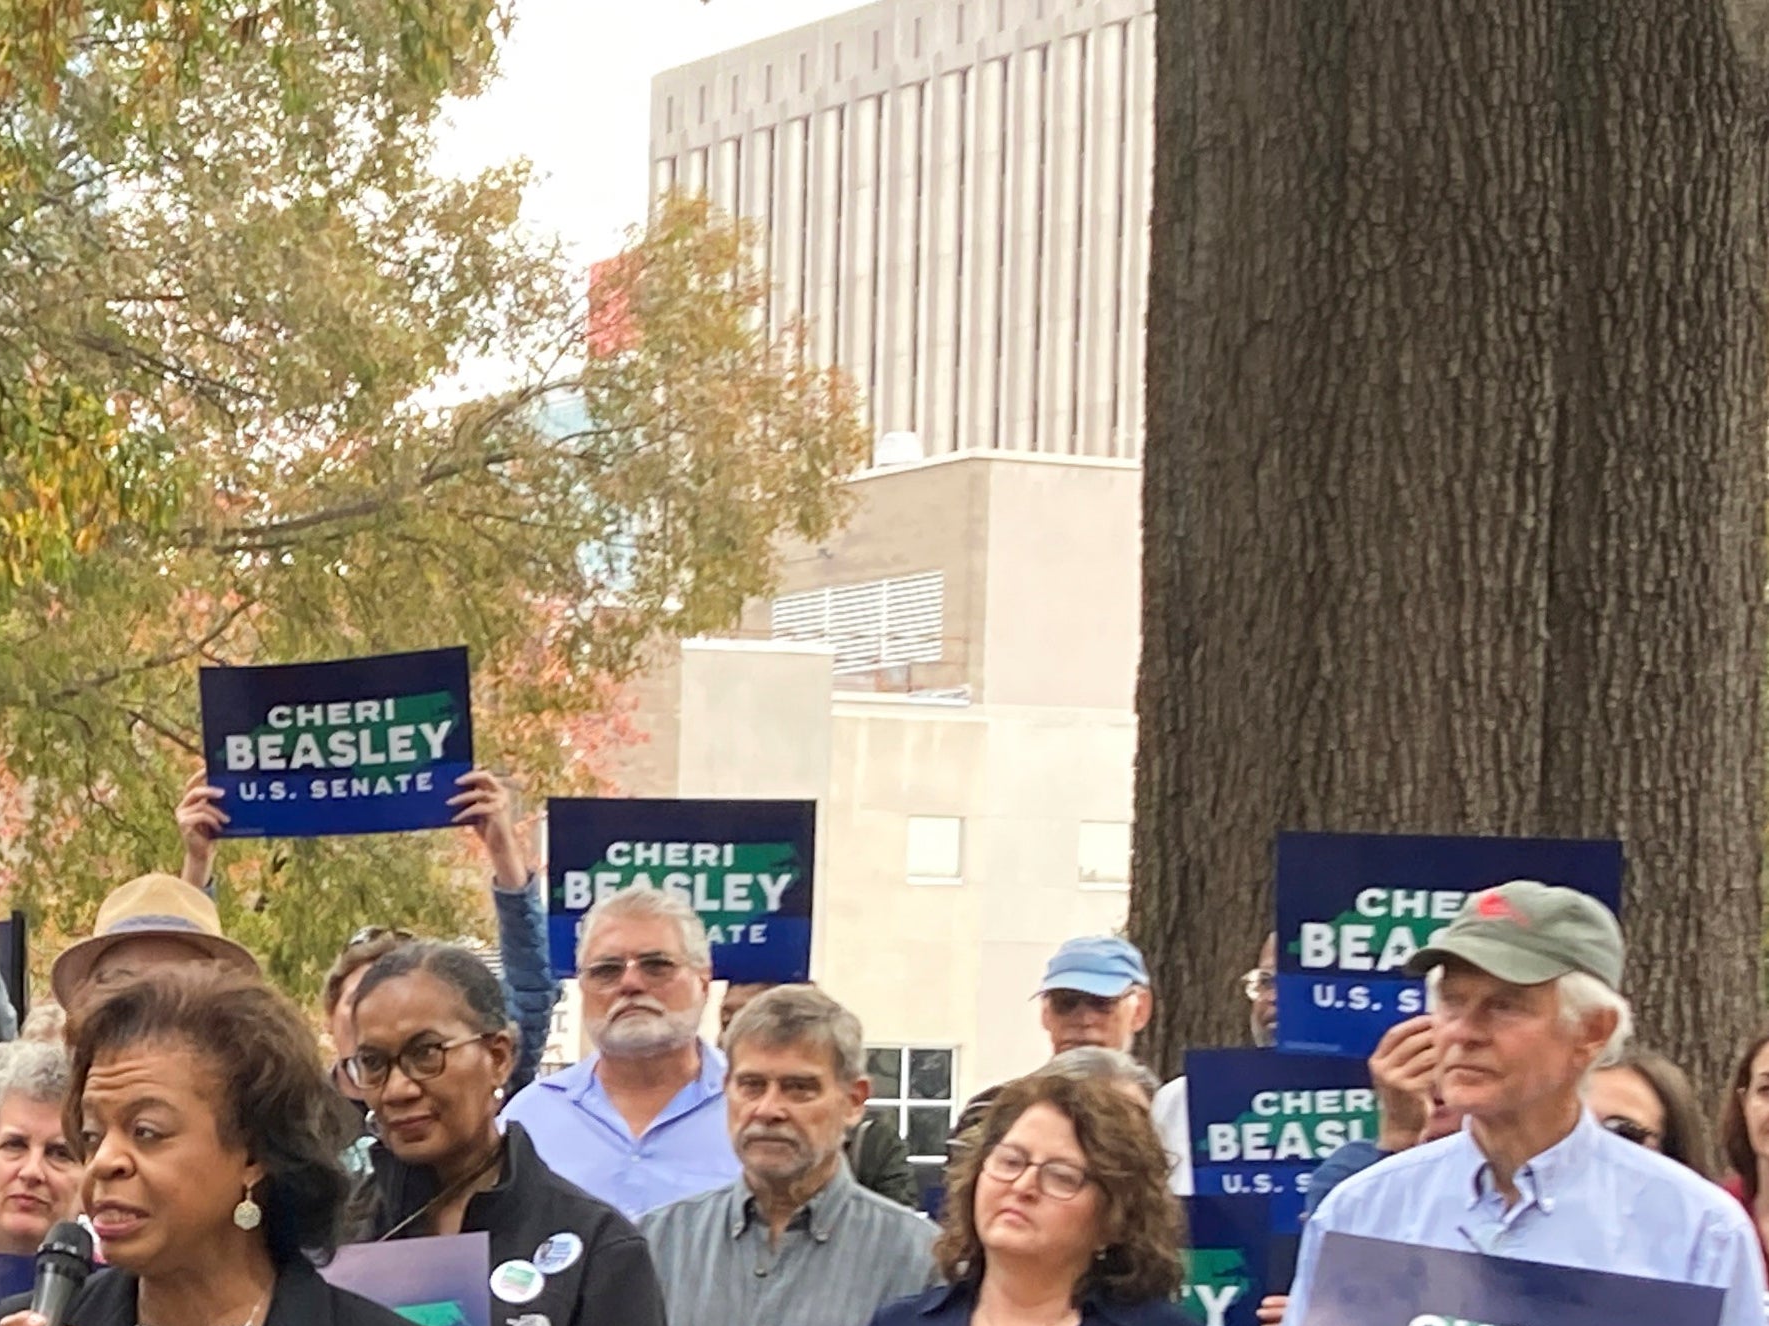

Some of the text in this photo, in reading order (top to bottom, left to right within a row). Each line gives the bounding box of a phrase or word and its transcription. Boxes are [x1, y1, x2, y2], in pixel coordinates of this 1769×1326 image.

[267, 698, 395, 729] CHERI
[225, 720, 453, 771] BEASLEY
[239, 772, 433, 801] U.S. SENATE
[606, 841, 735, 868] CHERI
[1355, 888, 1469, 919] CHE
[706, 923, 768, 944] ATE
[1313, 984, 1382, 1012] U.S.
[1251, 1088, 1376, 1117] CHER
[1207, 1118, 1367, 1161] BEAS
[1222, 1173, 1284, 1193] U.S.
